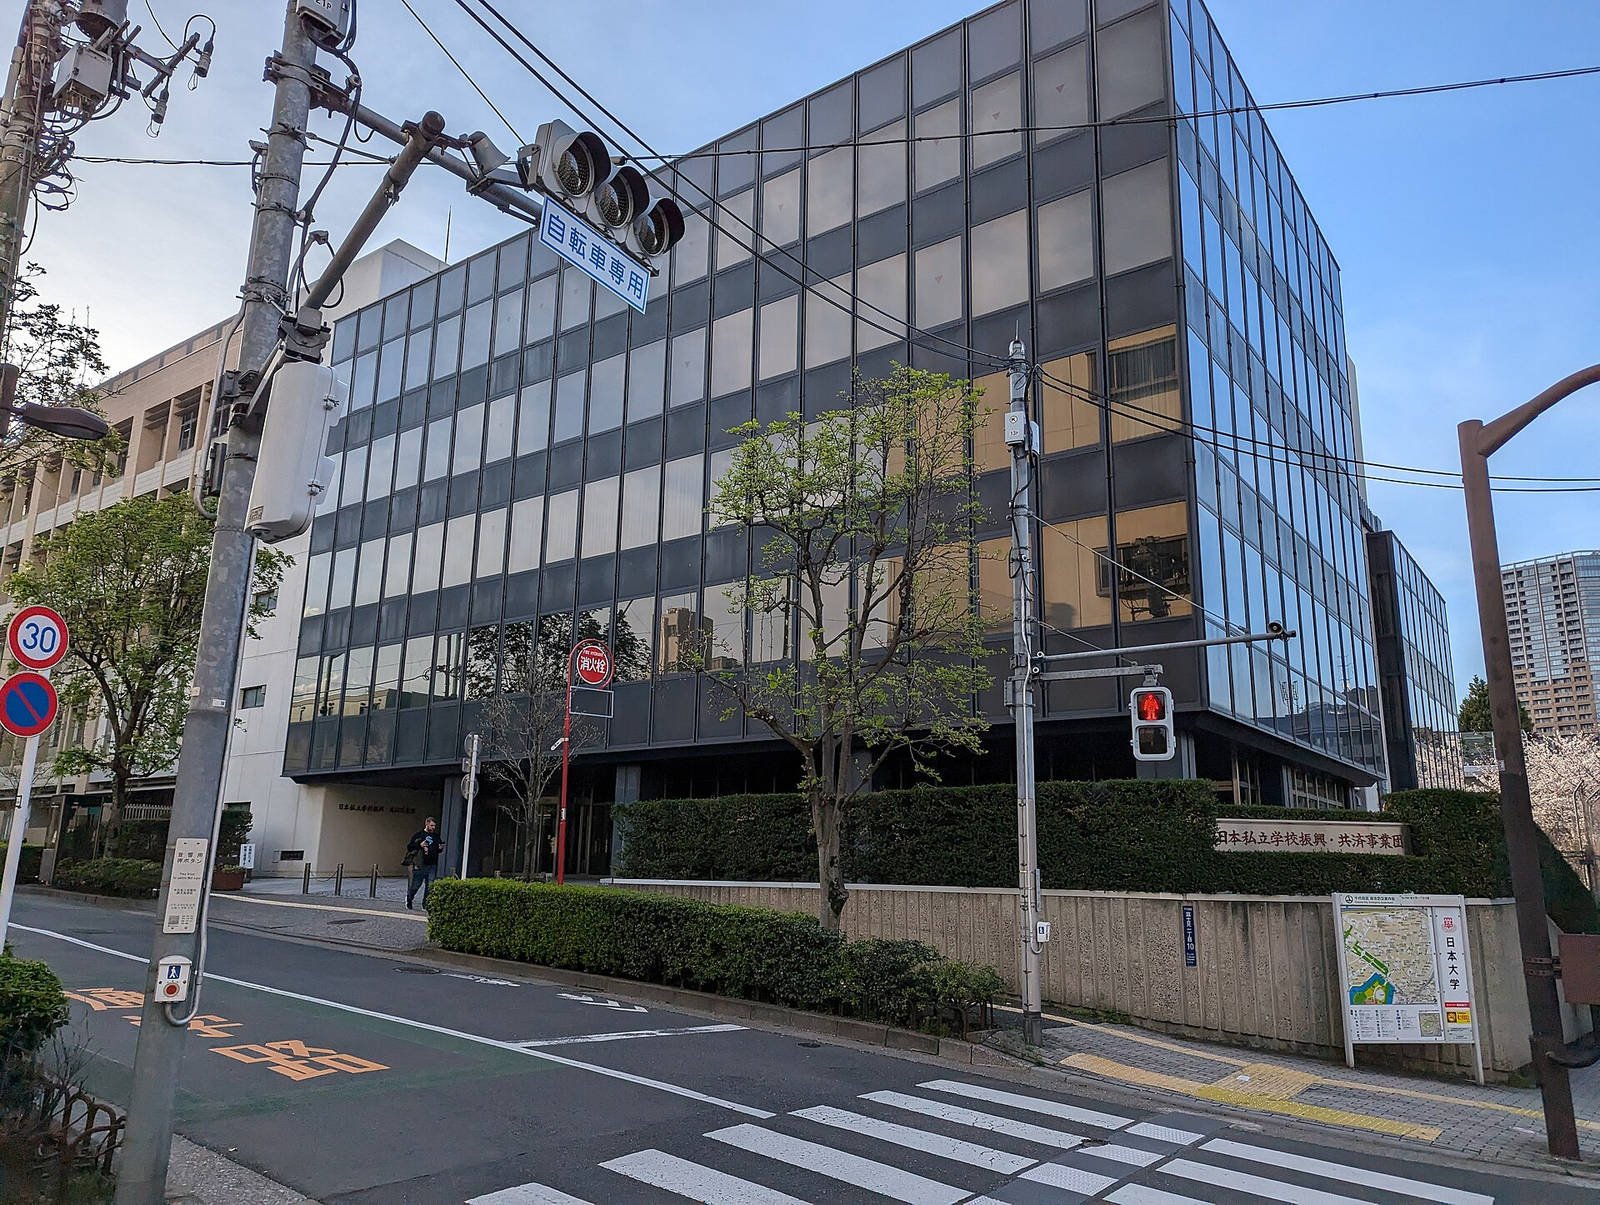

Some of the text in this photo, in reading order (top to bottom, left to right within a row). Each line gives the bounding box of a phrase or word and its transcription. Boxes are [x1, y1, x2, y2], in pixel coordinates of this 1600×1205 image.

[547, 213, 644, 300] 自転車専用
[22, 622, 57, 653] 30
[580, 655, 606, 674] 消火栓
[1217, 829, 1404, 849] 日本私立学校振興・共済事業団
[1446, 936, 1460, 990] 日本大学
